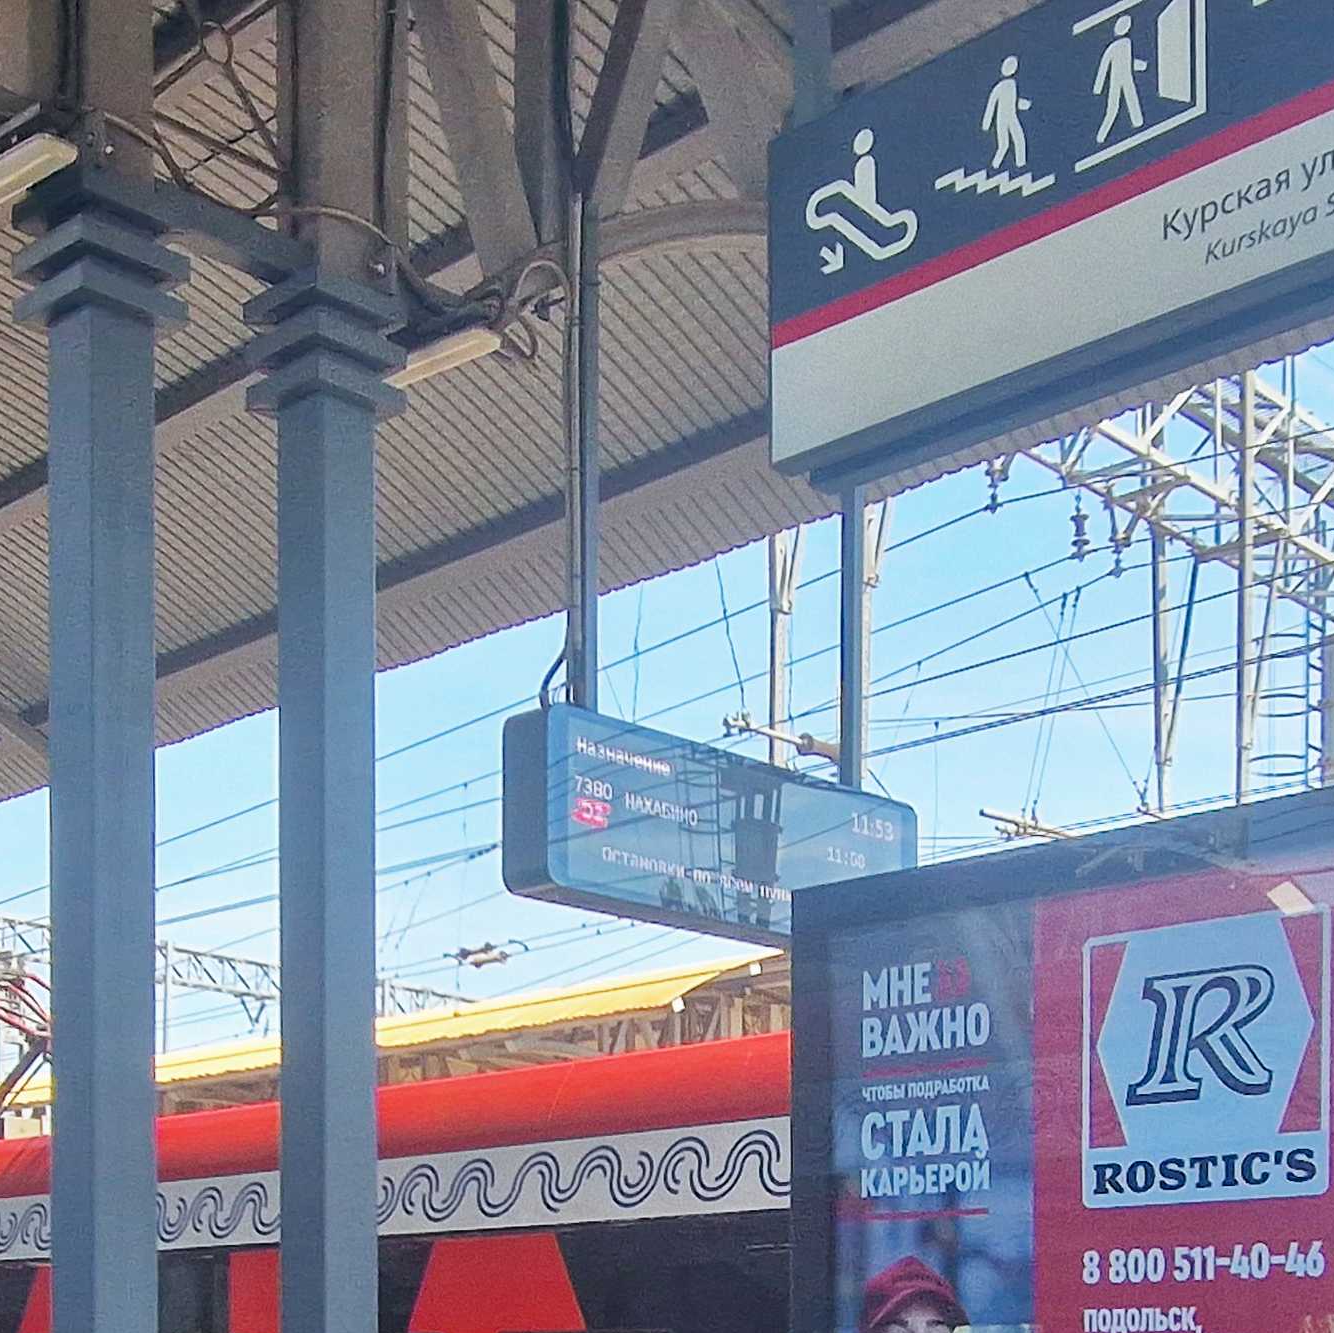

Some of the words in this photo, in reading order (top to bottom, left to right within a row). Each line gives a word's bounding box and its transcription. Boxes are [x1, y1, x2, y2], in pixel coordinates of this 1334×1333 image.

[1162, 168, 1291, 241] Курская
[1204, 205, 1317, 265] Kurskaya
[576, 735, 672, 777] Назначение
[624, 791, 699, 827] НАХАБИНО
[851, 811, 894, 842] 11:53
[862, 961, 932, 1011] МНЕ
[861, 1002, 991, 1058] ВАЖНО
[862, 1083, 907, 1102] ЧТОБЫ
[907, 1074, 990, 1100] ПОДРАБОТКА
[860, 1102, 990, 1160] СТАЛА
[860, 1153, 992, 1198] КАРЬЕРОЙ
[1092, 1147, 1317, 1195] ROSTIC'S
[1082, 1249, 1101, 1285] 8
[1108, 1248, 1166, 1284] 800
[1172, 1240, 1326, 1281] 511-40-46
